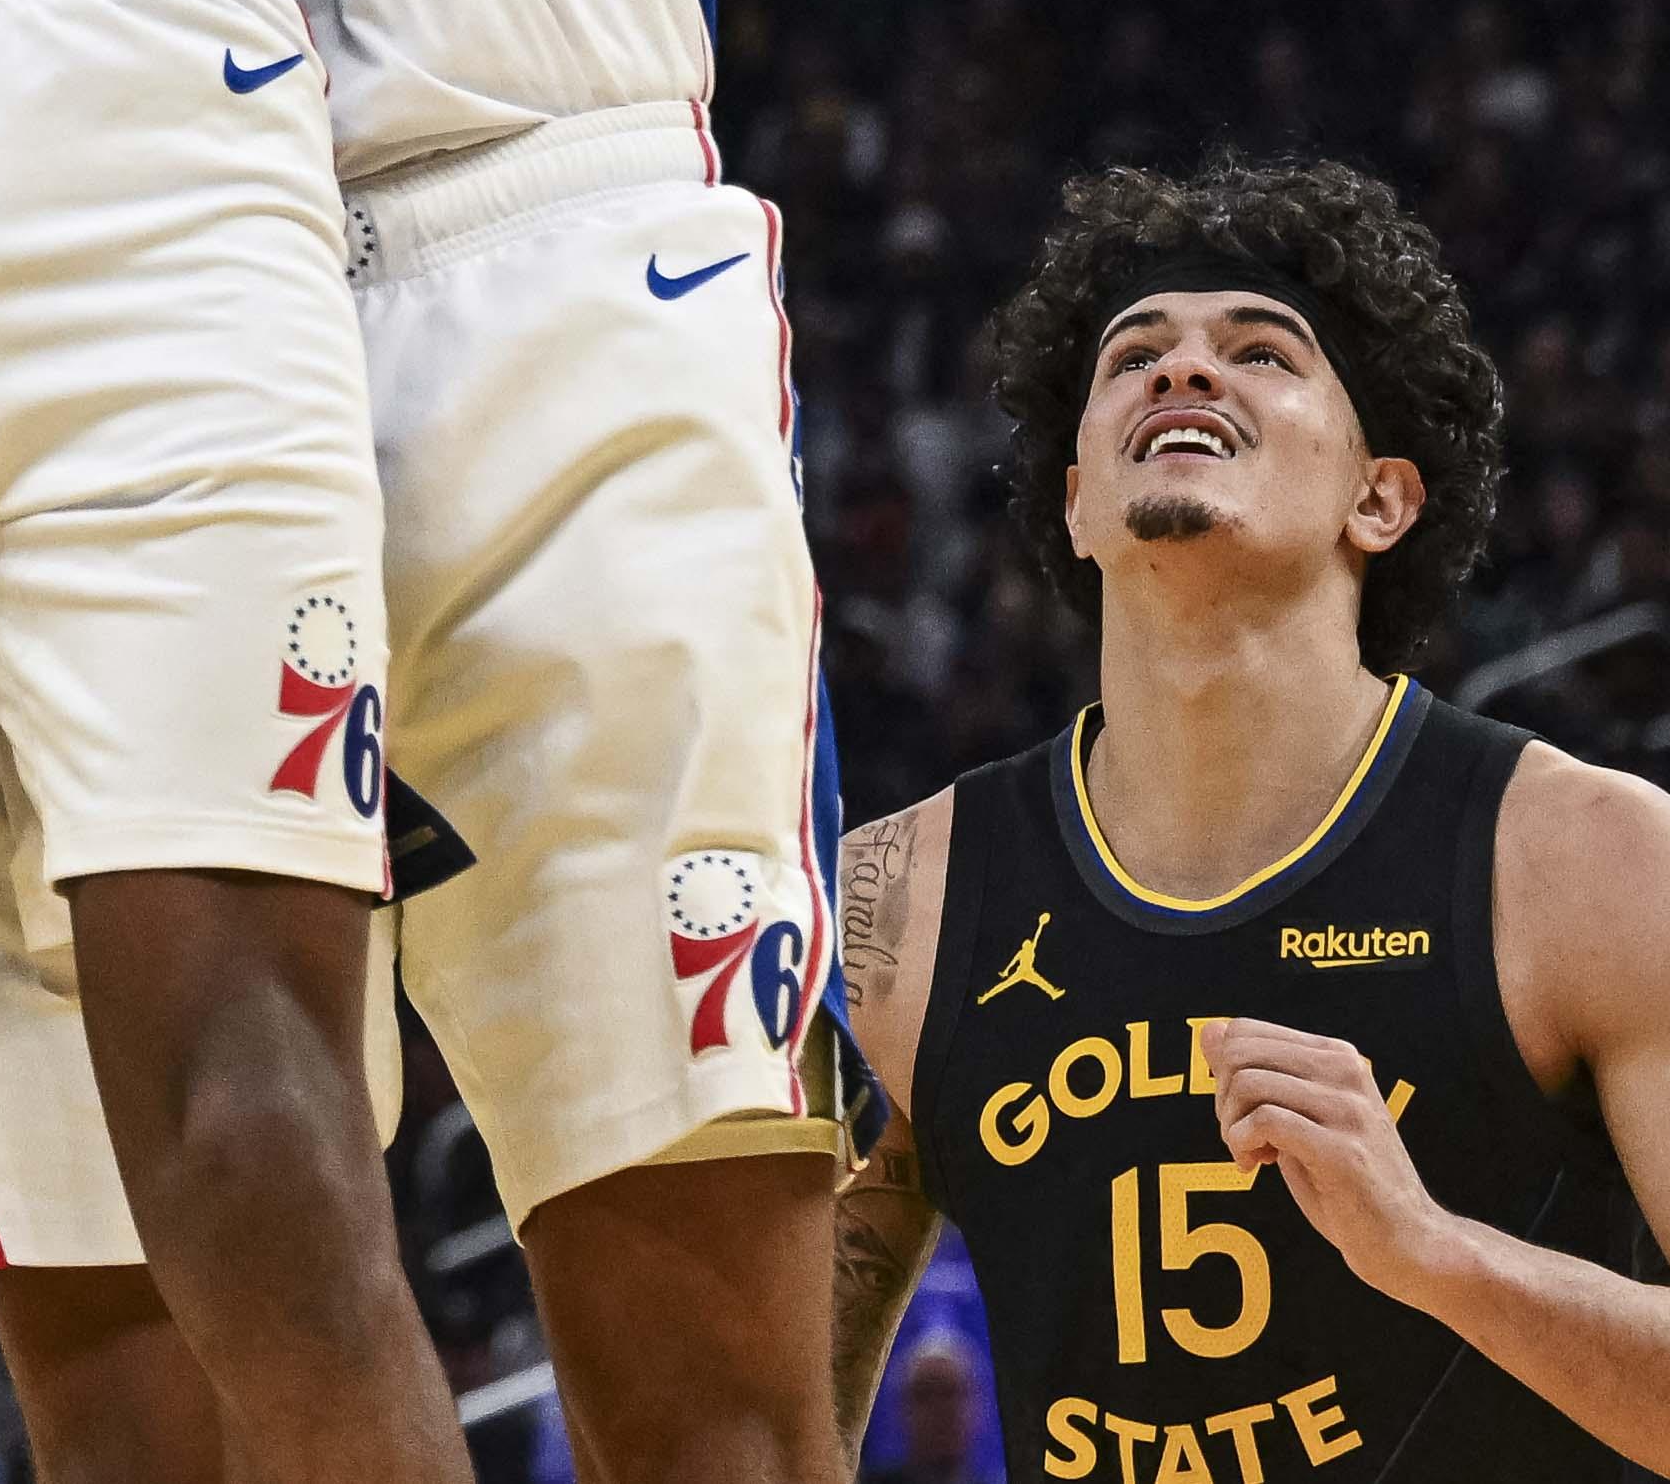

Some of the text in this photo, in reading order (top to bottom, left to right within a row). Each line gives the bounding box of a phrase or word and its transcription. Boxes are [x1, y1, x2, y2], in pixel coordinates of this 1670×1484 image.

[269, 659, 382, 818] 76
[670, 917, 803, 1054] 76
[1280, 925, 1430, 960] Rakuten
[1111, 1161, 1272, 1364] 15
[1044, 1375, 1362, 1484] STATE
